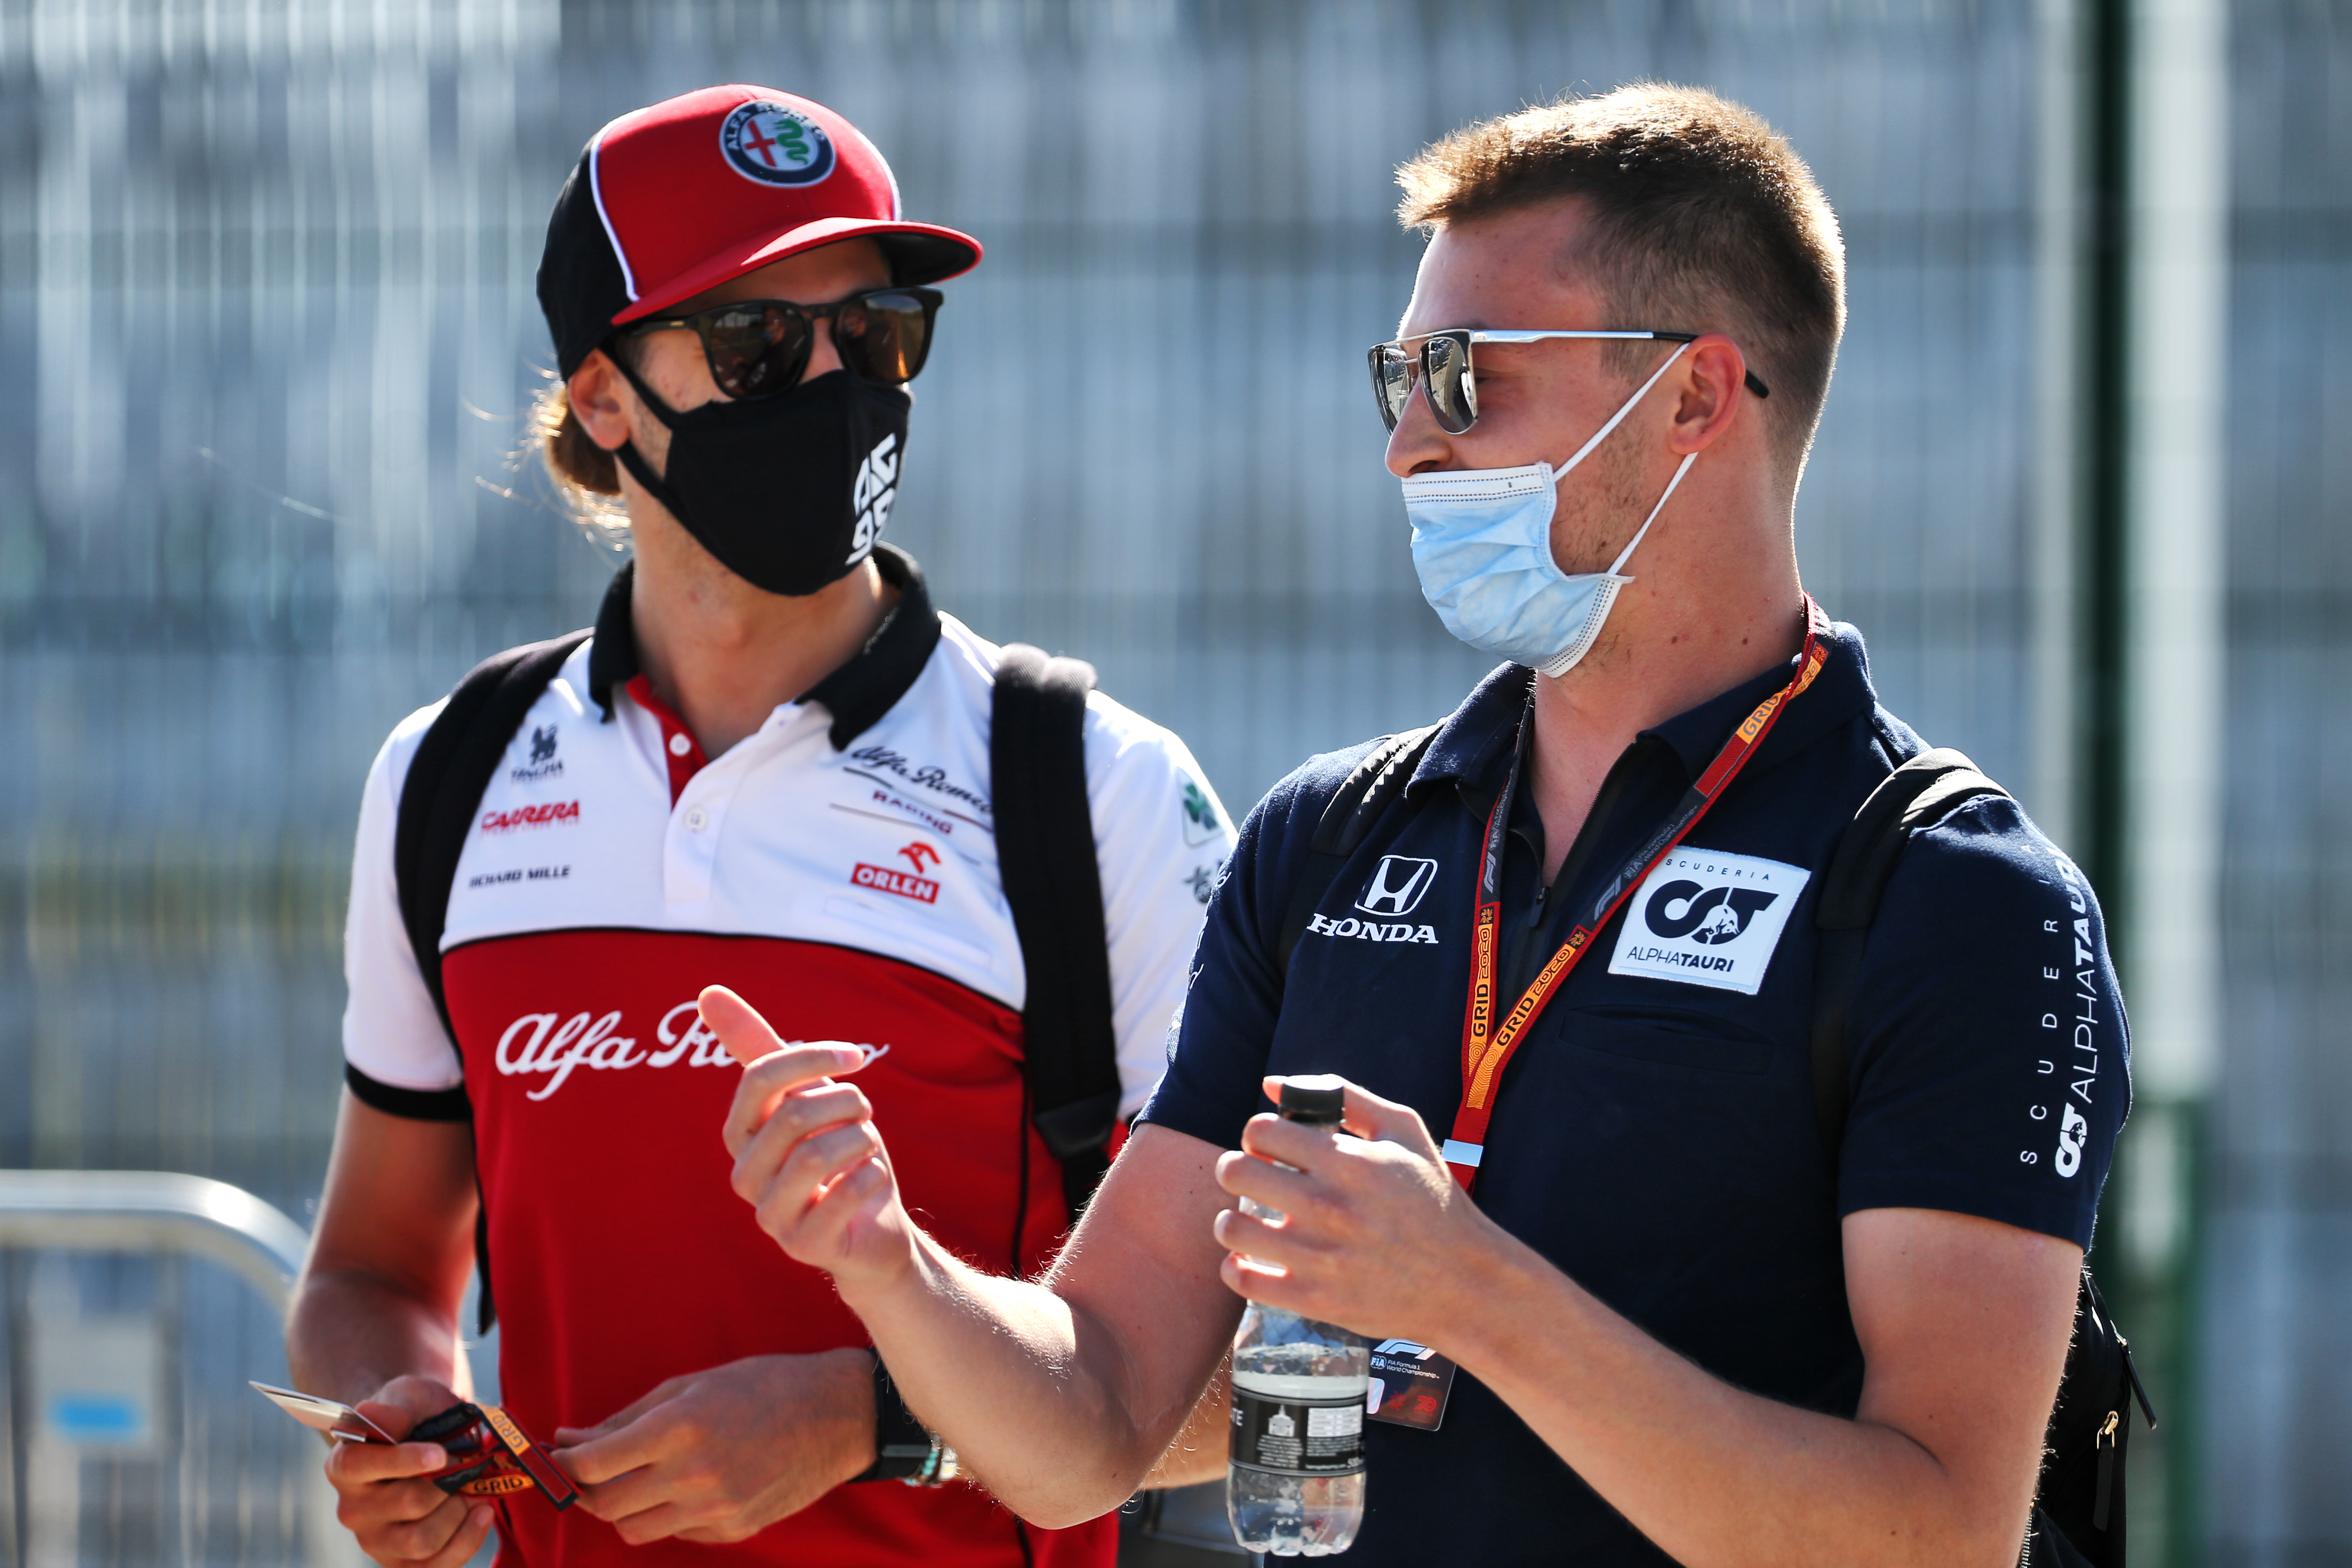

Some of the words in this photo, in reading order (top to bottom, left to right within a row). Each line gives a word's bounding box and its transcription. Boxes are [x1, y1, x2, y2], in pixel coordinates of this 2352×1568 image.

[726, 111, 752, 151] ALFA
[1743, 695, 1779, 736] GRID
[481, 799, 580, 831] CARRERA
[468, 868, 522, 888] RICHARD
[526, 864, 571, 880] MILLE
[856, 867, 934, 899] ORLEN
[1666, 858, 1770, 881] SCUDERIA
[1306, 913, 1439, 944] HONDA
[1478, 926, 1491, 979] 2020
[1627, 946, 1735, 972] ALPHATAURI
[1472, 984, 1490, 1038] GRID
[1497, 996, 1534, 1046] GRID
[1532, 948, 1571, 996] 2020
[495, 1010, 647, 1101] Alfa
[1386, 1364, 1401, 1372] World
[1396, 1361, 1416, 1369] Formula
[493, 1414, 524, 1448] GRID
[474, 1478, 523, 1492] GRID
